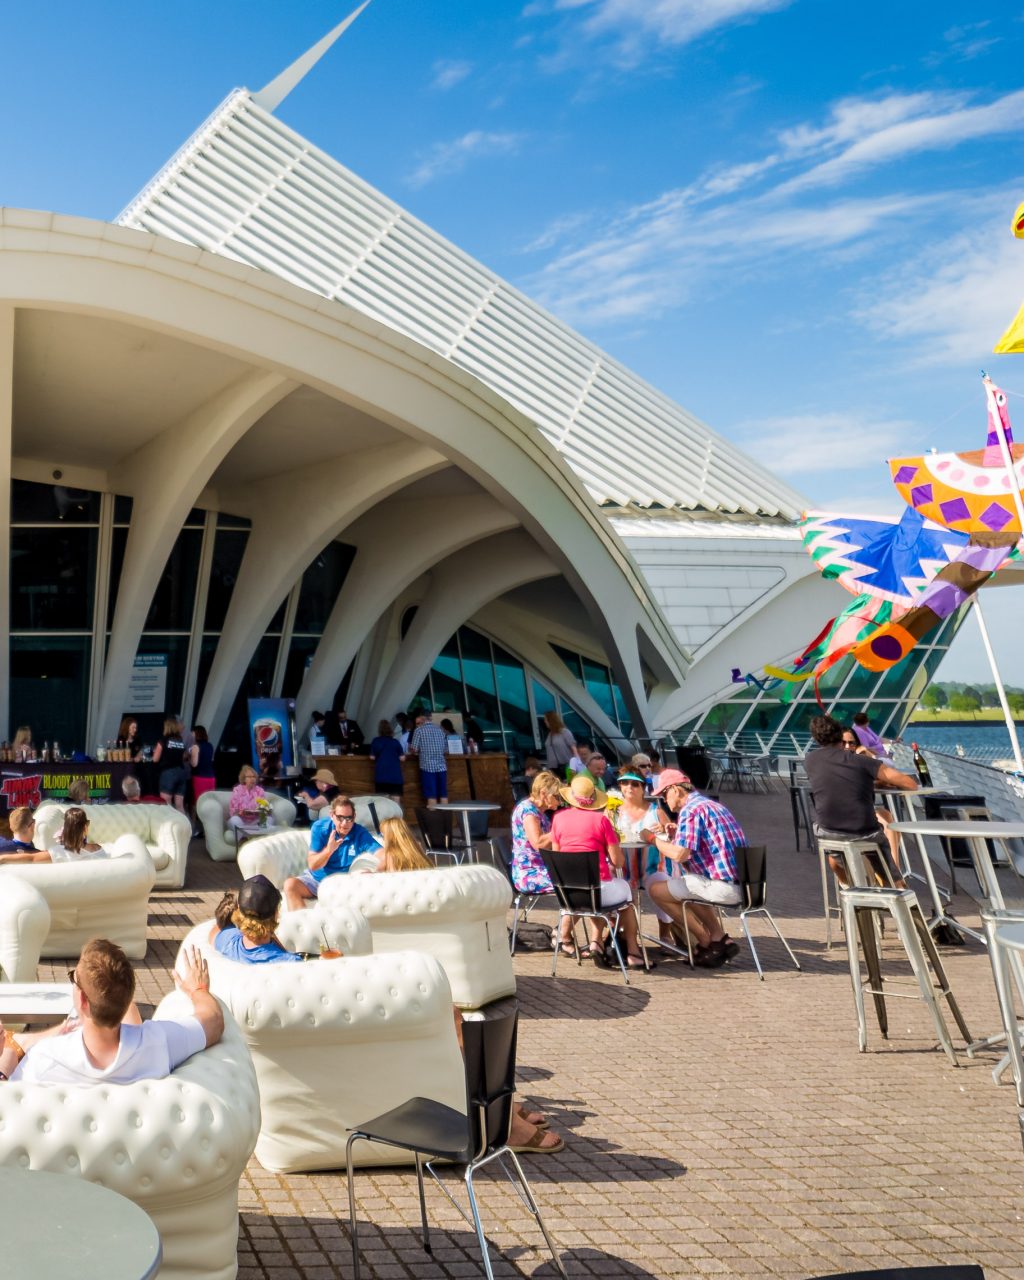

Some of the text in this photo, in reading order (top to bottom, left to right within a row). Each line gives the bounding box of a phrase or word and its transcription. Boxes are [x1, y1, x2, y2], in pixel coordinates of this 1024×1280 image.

[260, 746, 279, 754] pepsi
[43, 774, 71, 789] BLOODY
[95, 774, 111, 789] MIX
